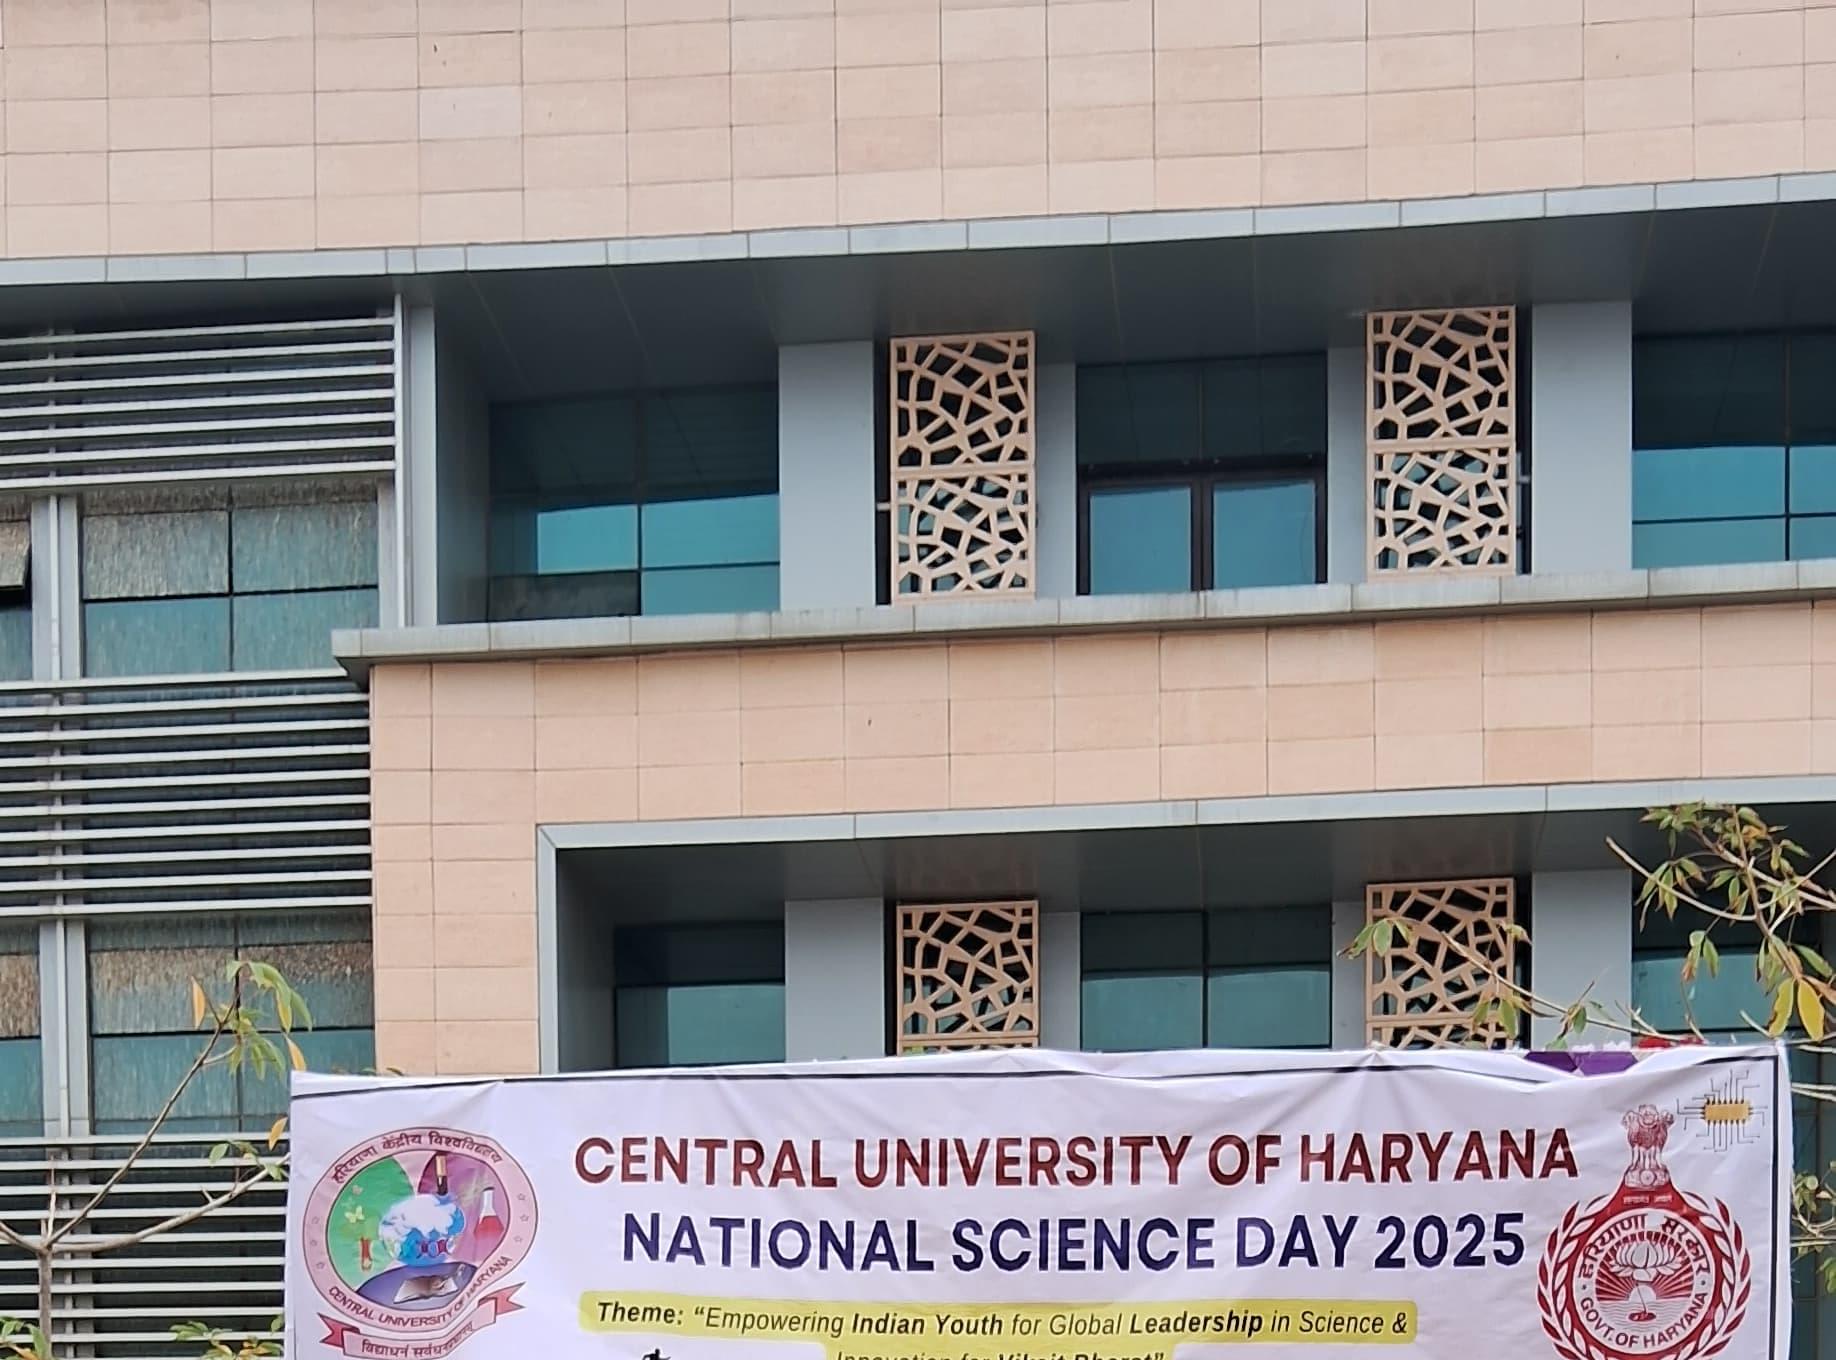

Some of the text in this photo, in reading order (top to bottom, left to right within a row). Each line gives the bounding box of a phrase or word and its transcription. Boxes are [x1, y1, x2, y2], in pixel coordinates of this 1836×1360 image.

[575, 1128, 1578, 1188] CENTRAL UNIVERSITY OF HARYANA
[624, 1212, 1525, 1272] NATIONAL SCIENCE DAY 2025
[1579, 1213, 1711, 1279] हरियाणा सरकार
[328, 1255, 512, 1327] CENTRAL UNIVERSITY OF HARYANA
[598, 1302, 683, 1325] Theme:
[852, 1313, 925, 1335] Indian
[936, 1314, 1002, 1335] Youth
[1011, 1313, 1042, 1335] for
[1050, 1313, 1122, 1335] Global
[1129, 1309, 1263, 1338] Leadership
[1271, 1311, 1290, 1333] in
[1299, 1310, 1384, 1333] Science
[1392, 1311, 1407, 1333] &
[1581, 1292, 1708, 1349] GOVT. OF HARYANA
